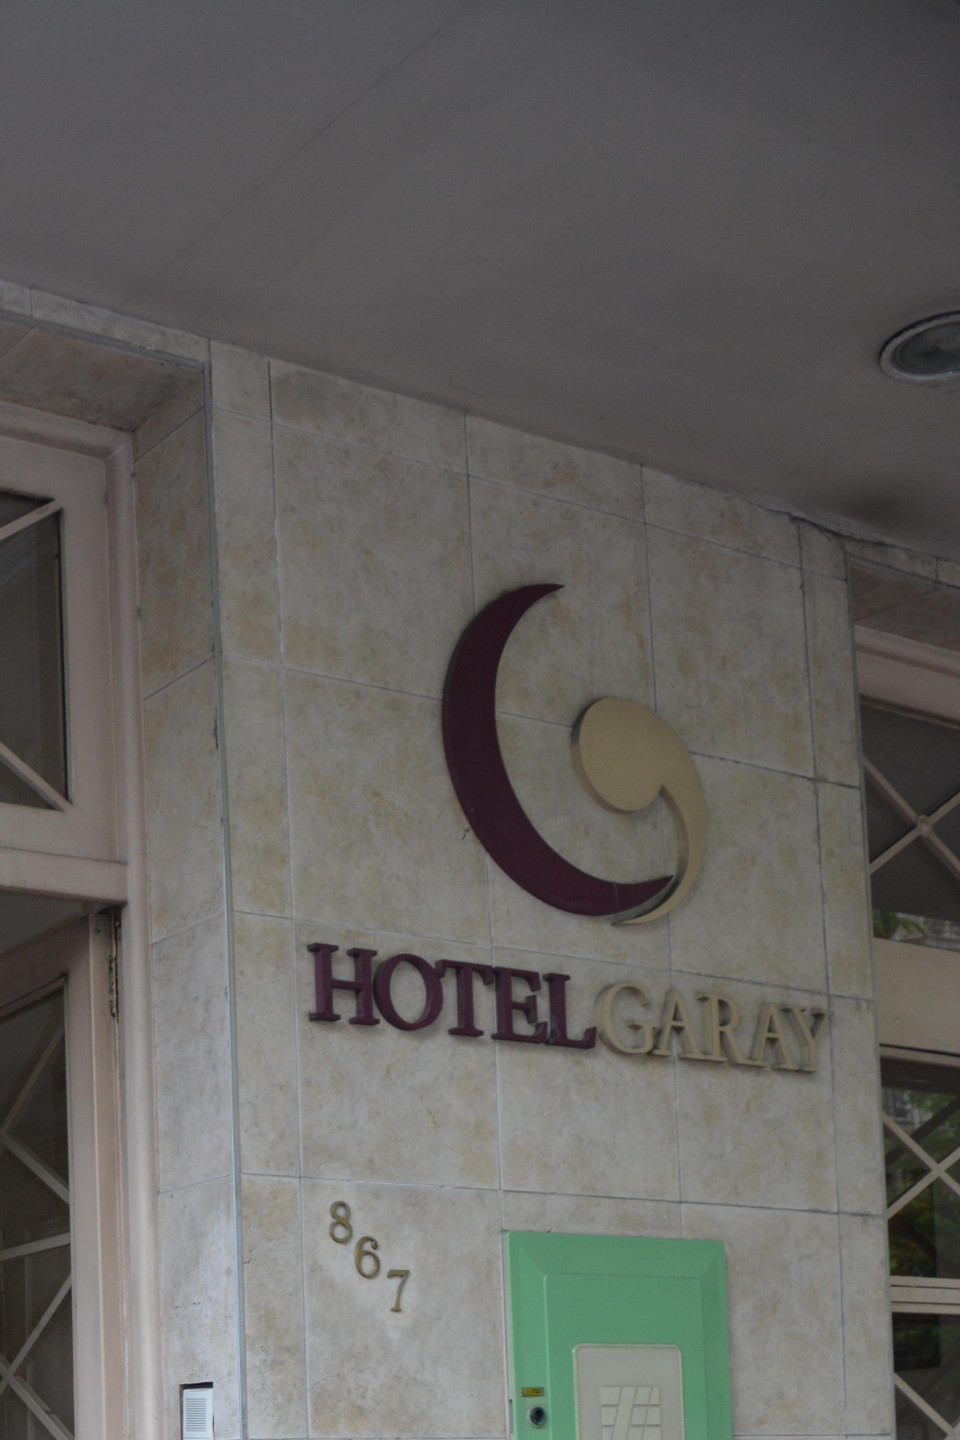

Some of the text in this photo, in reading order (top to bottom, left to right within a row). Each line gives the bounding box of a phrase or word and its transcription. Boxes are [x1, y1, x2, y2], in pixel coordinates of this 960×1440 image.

[306, 942, 831, 1074] HOTEL GARAY
[329, 1200, 410, 1313] 867
